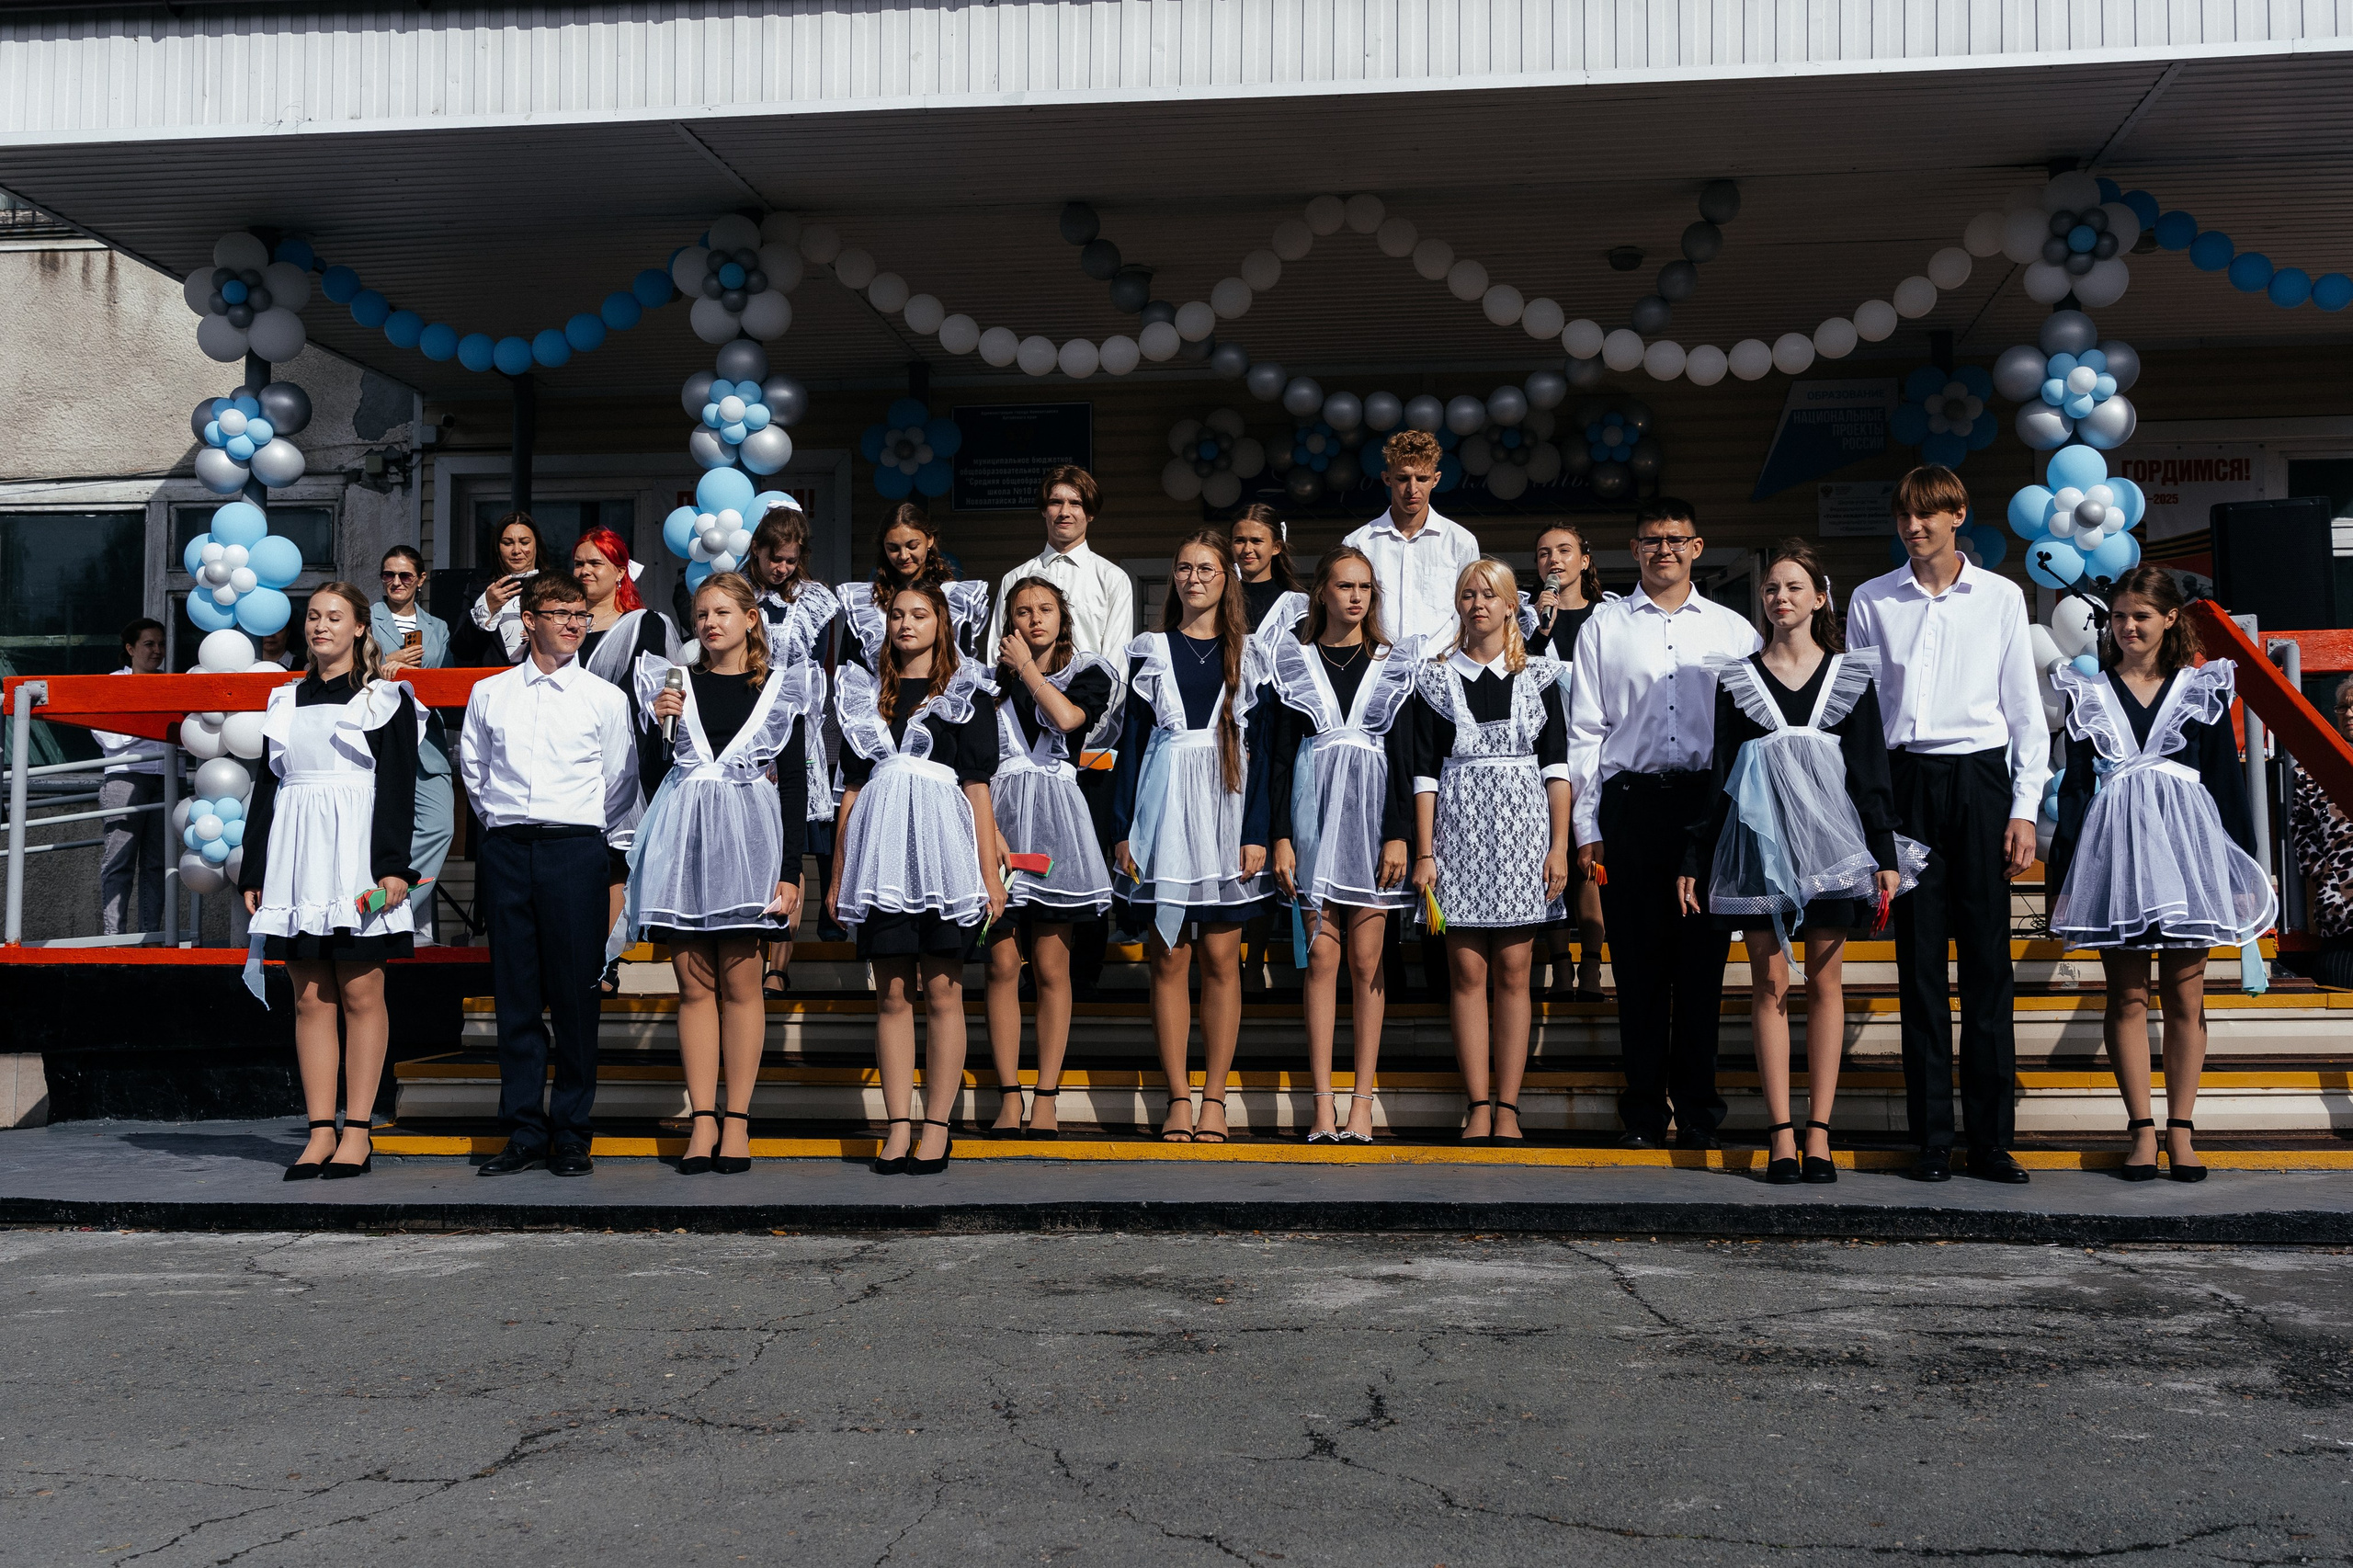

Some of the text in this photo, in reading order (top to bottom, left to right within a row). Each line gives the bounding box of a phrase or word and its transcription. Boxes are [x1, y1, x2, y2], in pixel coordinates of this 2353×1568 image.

[1807, 389, 1885, 401] ОБРАЗОВАНИЕ
[1793, 408, 1883, 425] НАЦИОНАЛЬНЫЕ
[1832, 423, 1883, 437] ПРОЕКТЫ
[1842, 436, 1884, 450] РОССИИ
[973, 456, 1074, 466] муниципальное бюджетное
[960, 467, 1040, 476] общеобразовательное
[2121, 458, 2251, 485] ГОРДИМСЯ!
[1013, 487, 1031, 495] №10
[965, 497, 1017, 506] Новоалтайска
[2143, 494, 2178, 505] –2025
